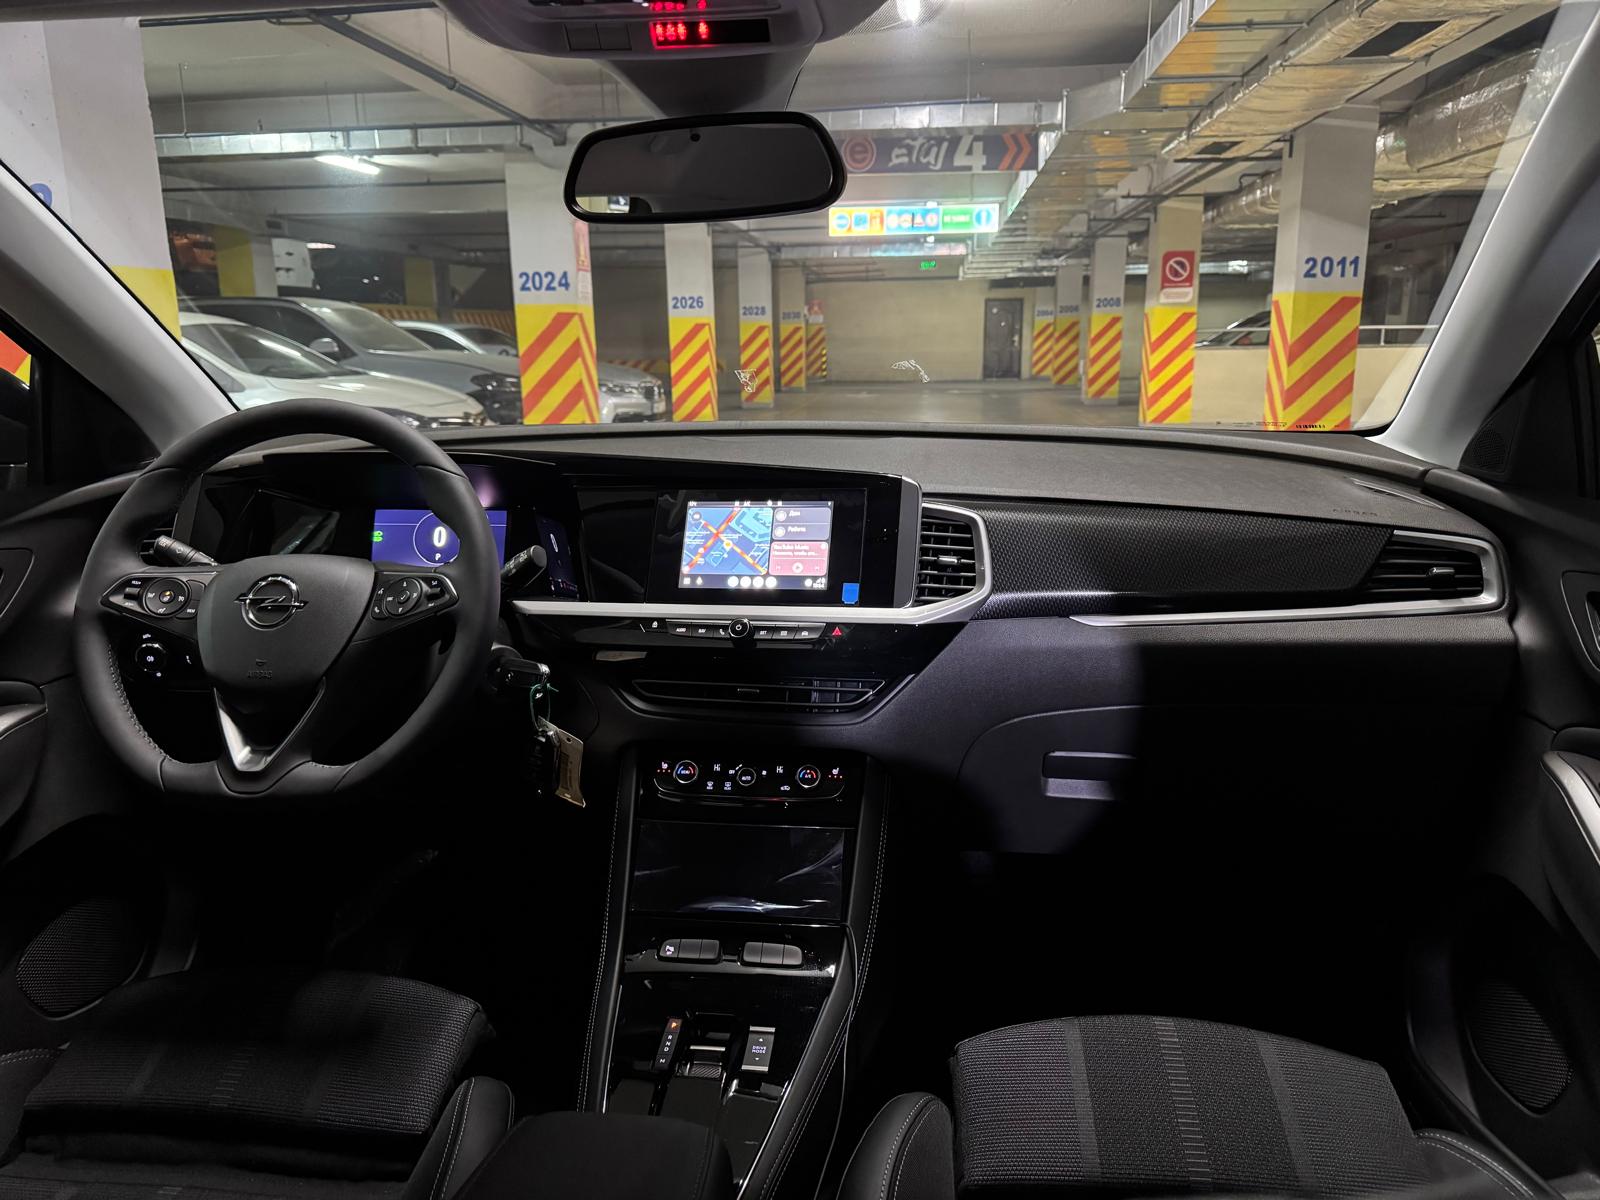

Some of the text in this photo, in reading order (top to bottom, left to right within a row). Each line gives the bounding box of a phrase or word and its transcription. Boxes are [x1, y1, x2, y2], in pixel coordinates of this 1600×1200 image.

[953, 133, 986, 172] 4
[1303, 256, 1360, 278] 2011
[519, 271, 570, 292] 2024
[672, 296, 704, 310] 2026
[742, 306, 766, 316] 2028
[1096, 297, 1121, 308] 2008
[433, 526, 446, 547] 0
[435, 553, 441, 561] P
